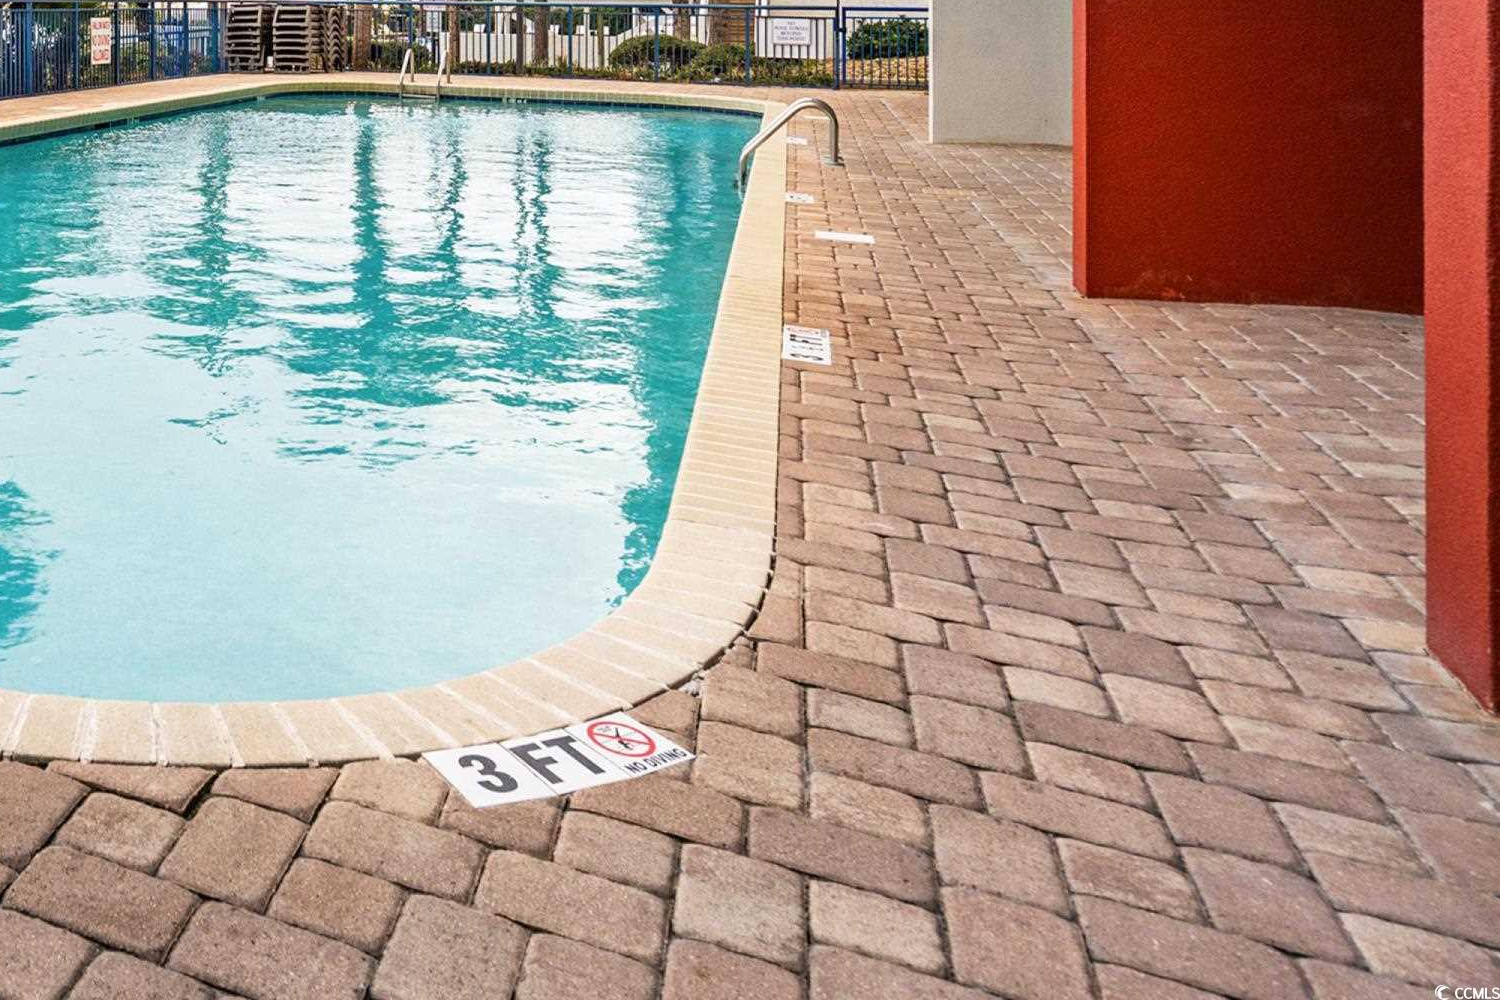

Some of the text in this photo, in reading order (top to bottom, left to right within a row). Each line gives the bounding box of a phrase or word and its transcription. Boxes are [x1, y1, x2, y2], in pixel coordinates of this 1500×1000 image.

[458, 735, 606, 793] 3 FT
[625, 747, 687, 775] NO DIVING
